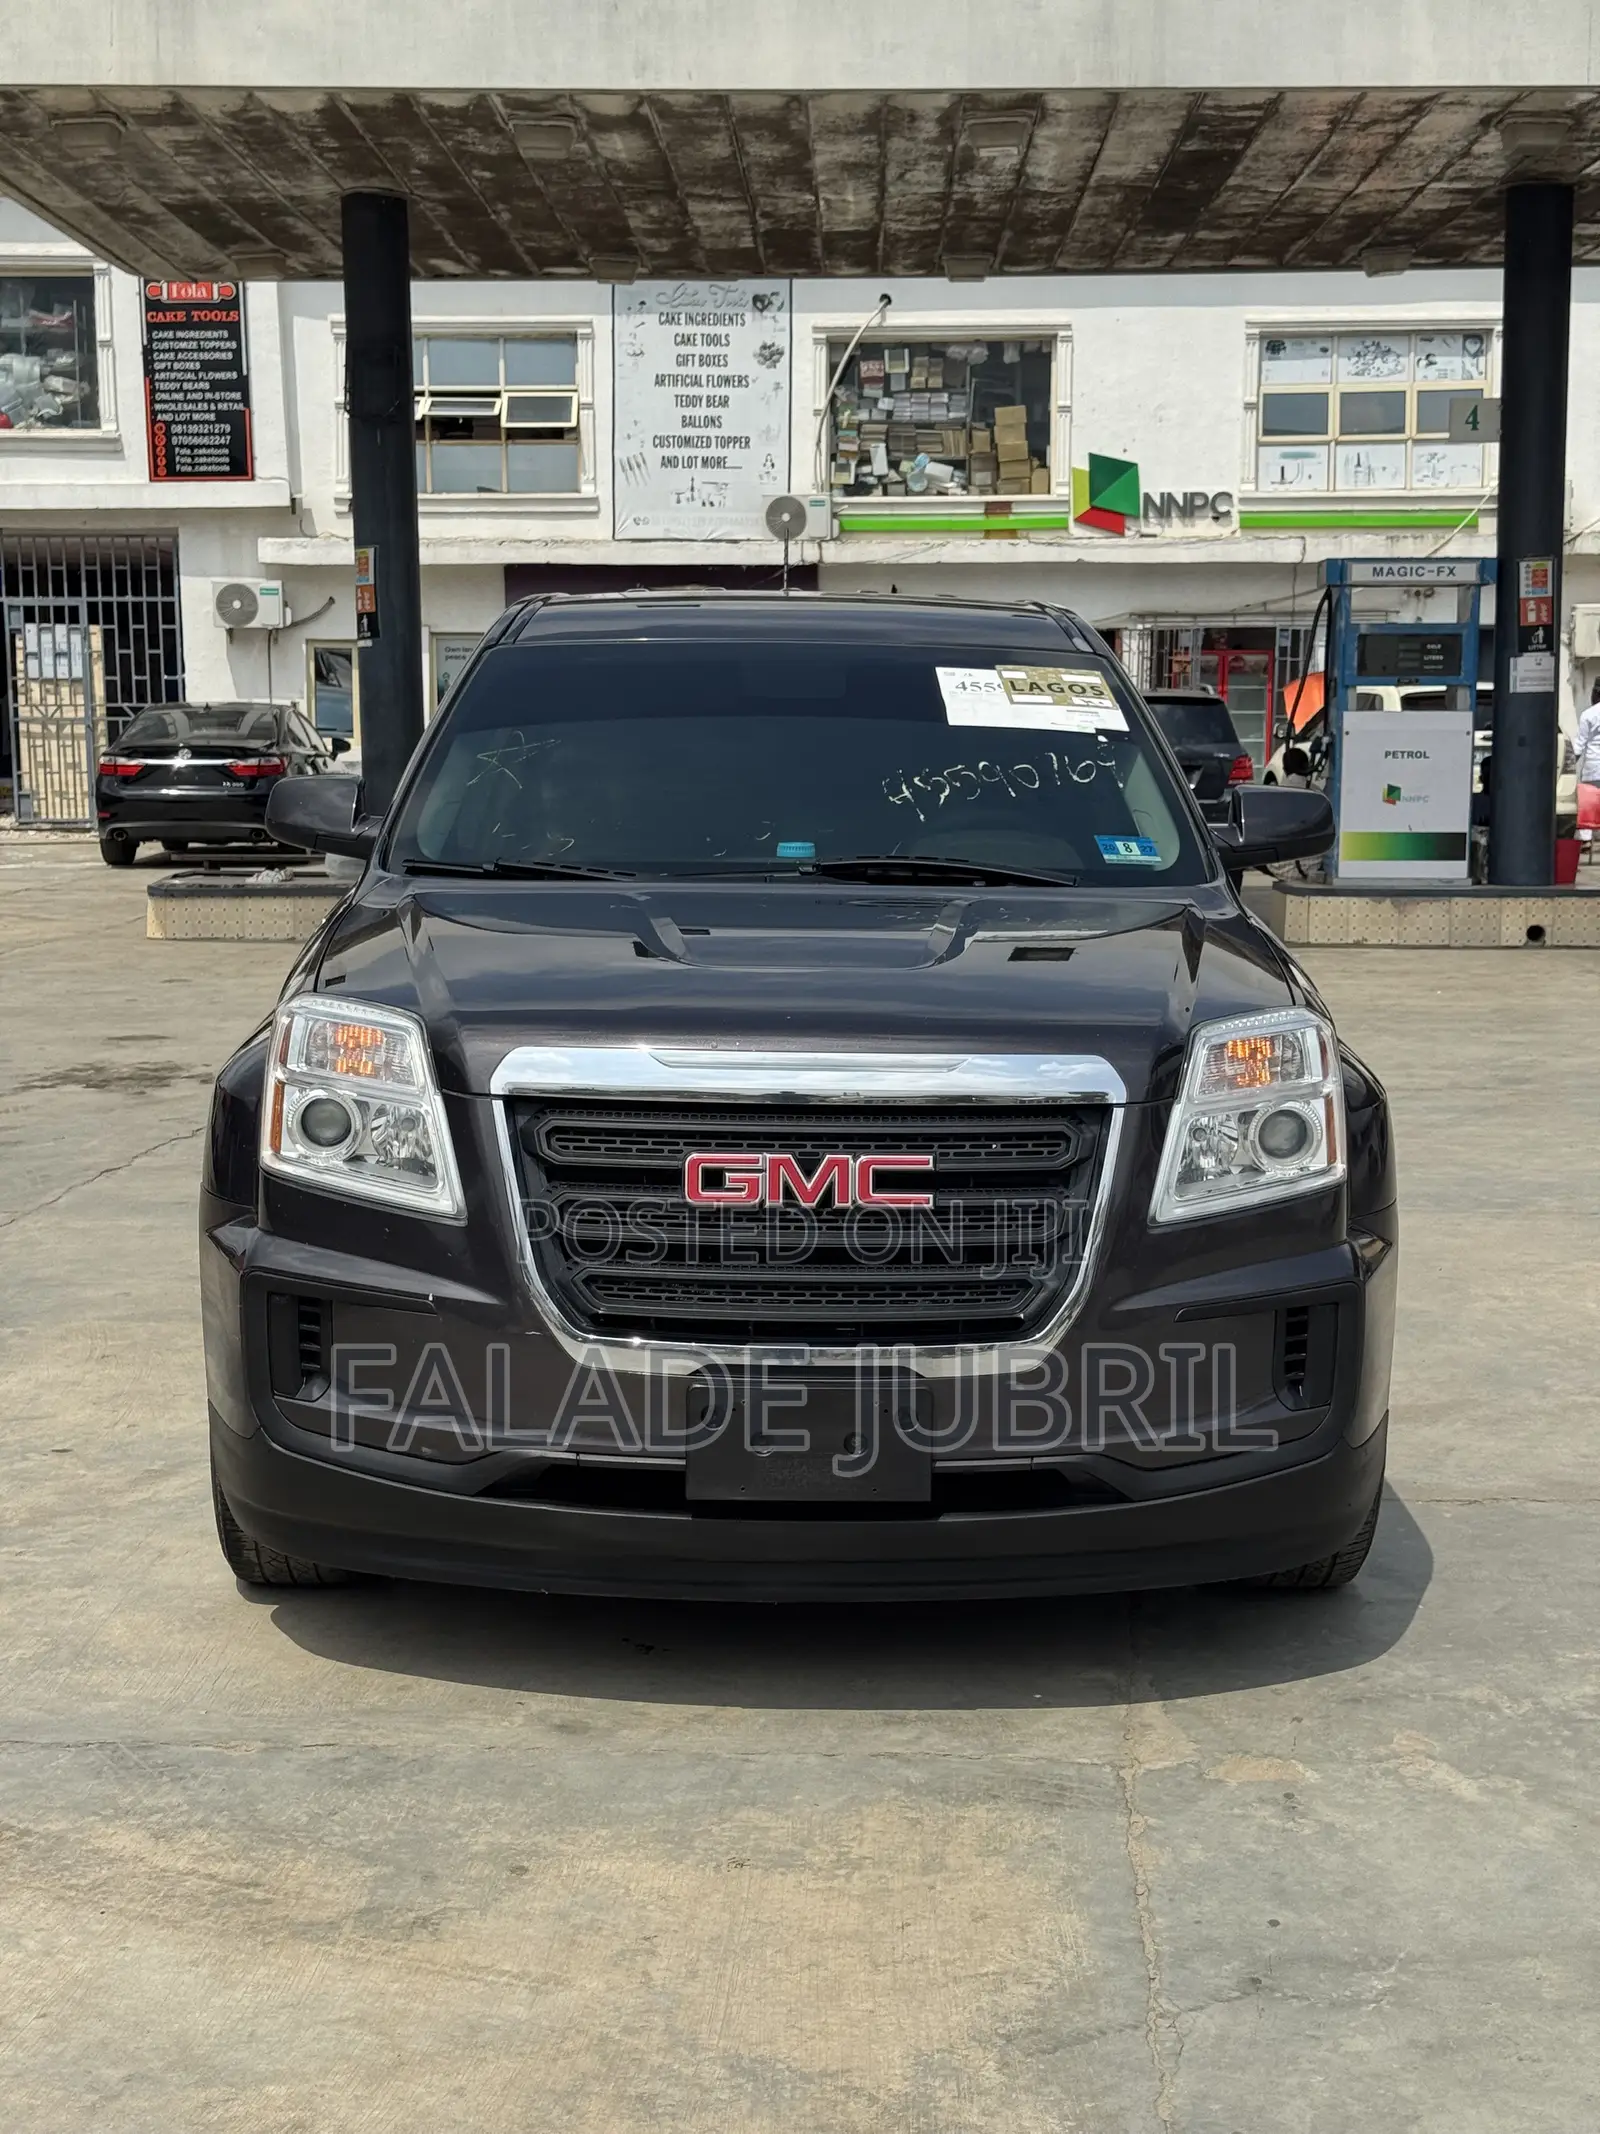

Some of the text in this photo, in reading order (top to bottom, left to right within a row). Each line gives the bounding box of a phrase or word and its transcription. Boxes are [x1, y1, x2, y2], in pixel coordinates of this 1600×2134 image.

[147, 310, 239, 322] CAKE TOOLS
[658, 312, 746, 327] CAKE INGREDIENTS
[152, 329, 229, 339] CAKE INGREDIENTS
[673, 333, 730, 347] CAKE TOOLS
[152, 340, 237, 350] CUSTOMIZE TOPPERS
[153, 351, 234, 361] CAKE ACCESSORIES
[675, 354, 729, 367] GIFT BOXES
[153, 361, 201, 370] GIFT BOXES
[154, 371, 238, 381] ARTIFICIAL FLOWERS
[654, 374, 750, 388] ARTIFICIAL FLOWERS
[154, 381, 211, 391] TEDDY BEARS
[155, 393, 185, 401] ONLINE
[186, 392, 203, 401] AND
[674, 394, 730, 408] TEDDY BEAR
[154, 403, 208, 412] WHOLESALES
[209, 403, 217, 411] &
[157, 412, 216, 421] AND LOT MORE
[681, 415, 722, 429] BALLONS
[1465, 405, 1480, 431] 4
[652, 435, 751, 449] CUSTOMIZED TOPPER
[660, 456, 680, 470] AND
[681, 456, 700, 469] LOT
[1142, 491, 1234, 520] NNPC
[1372, 565, 1457, 578] MAGIC-FX
[1008, 680, 1106, 697] LAGOS
[1384, 750, 1430, 760] PETROL
[1401, 795, 1430, 804] NNPC
[1123, 842, 1134, 853] 8
[684, 1153, 934, 1209] GMC
